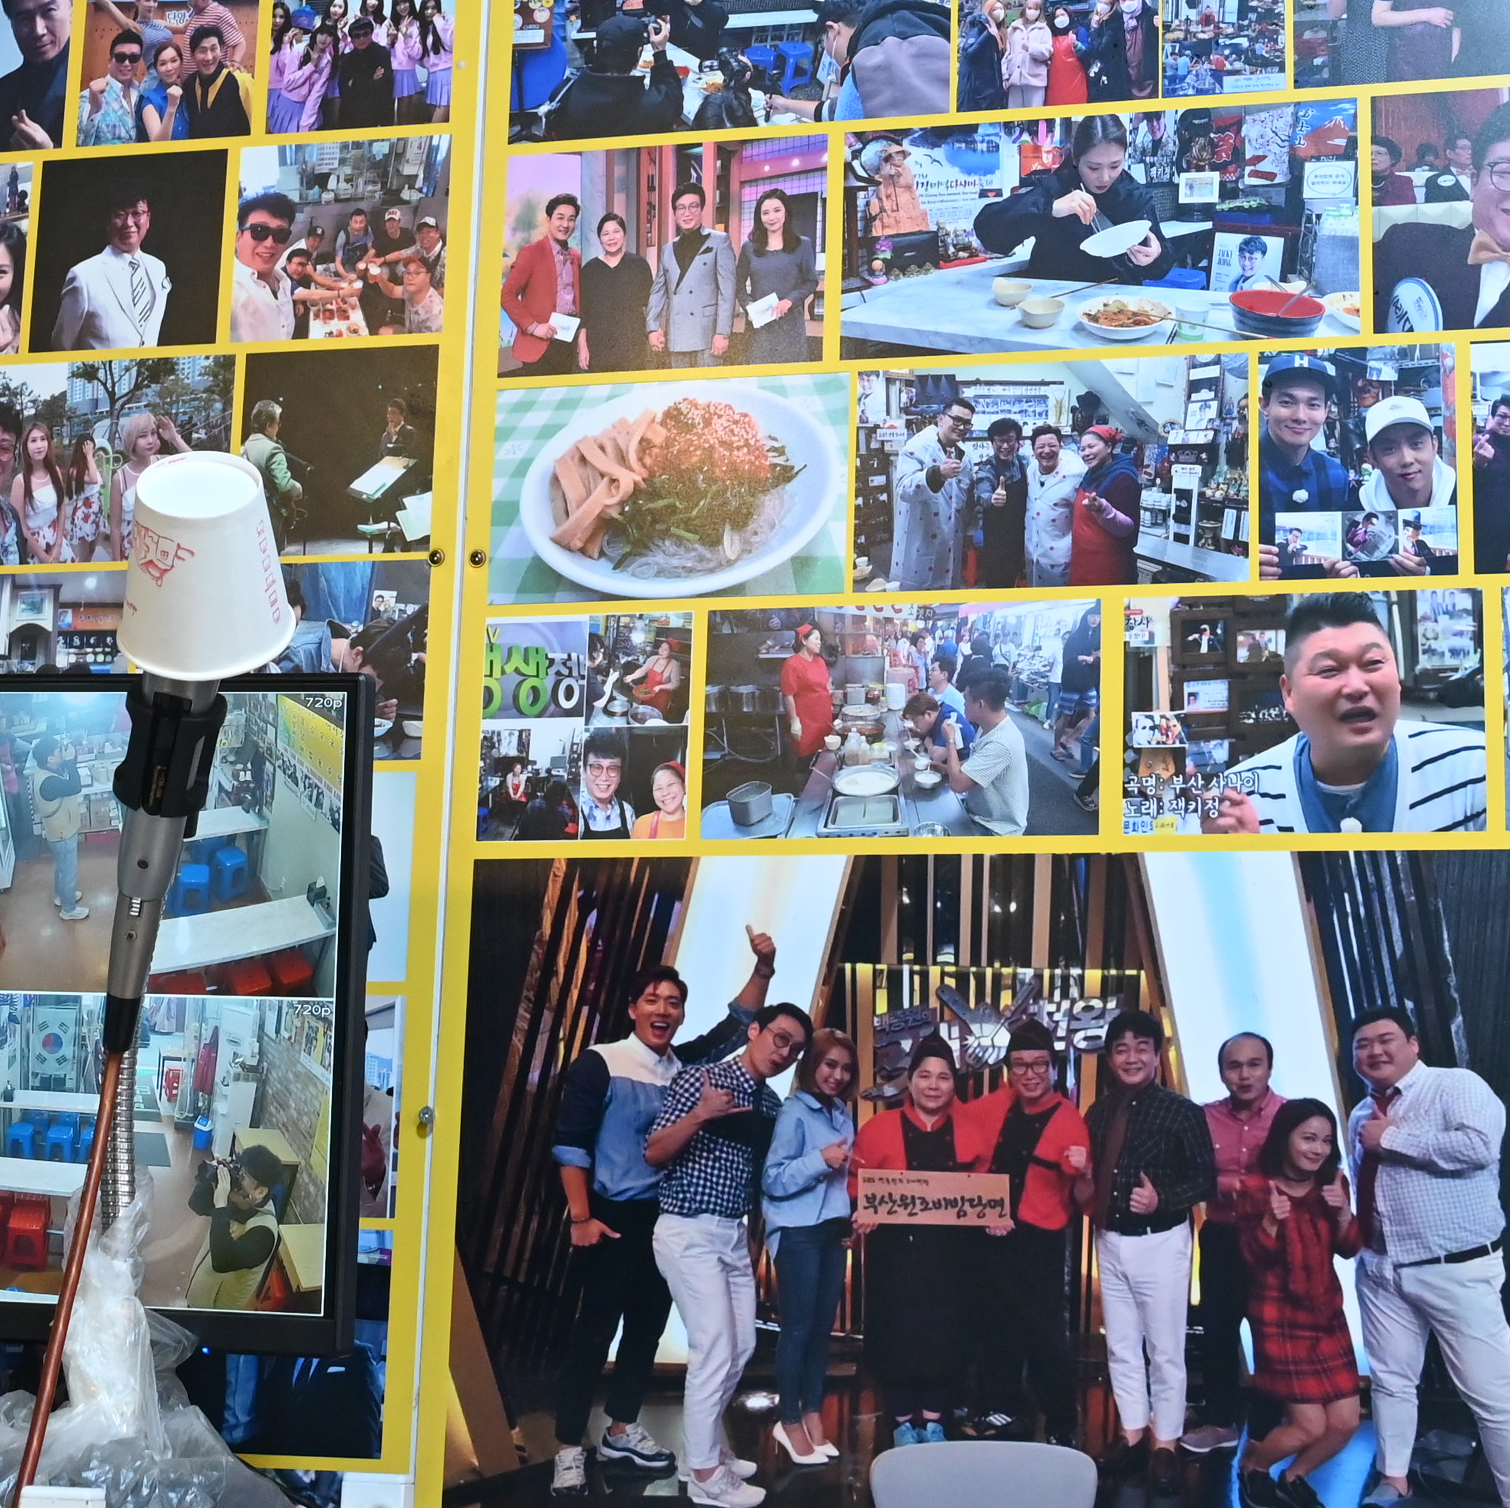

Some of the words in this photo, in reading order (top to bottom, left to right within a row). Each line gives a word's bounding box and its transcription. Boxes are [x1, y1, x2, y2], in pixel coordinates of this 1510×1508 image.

[305, 696, 343, 710] 720p
[1169, 773, 1204, 794] 부산
[1208, 772, 1259, 794] 사나이
[1124, 797, 1164, 818] 노래:
[1169, 797, 1220, 818] 잭키정
[293, 1003, 332, 1018] 720p
[863, 1192, 1008, 1219] 부산원조비빔당면
